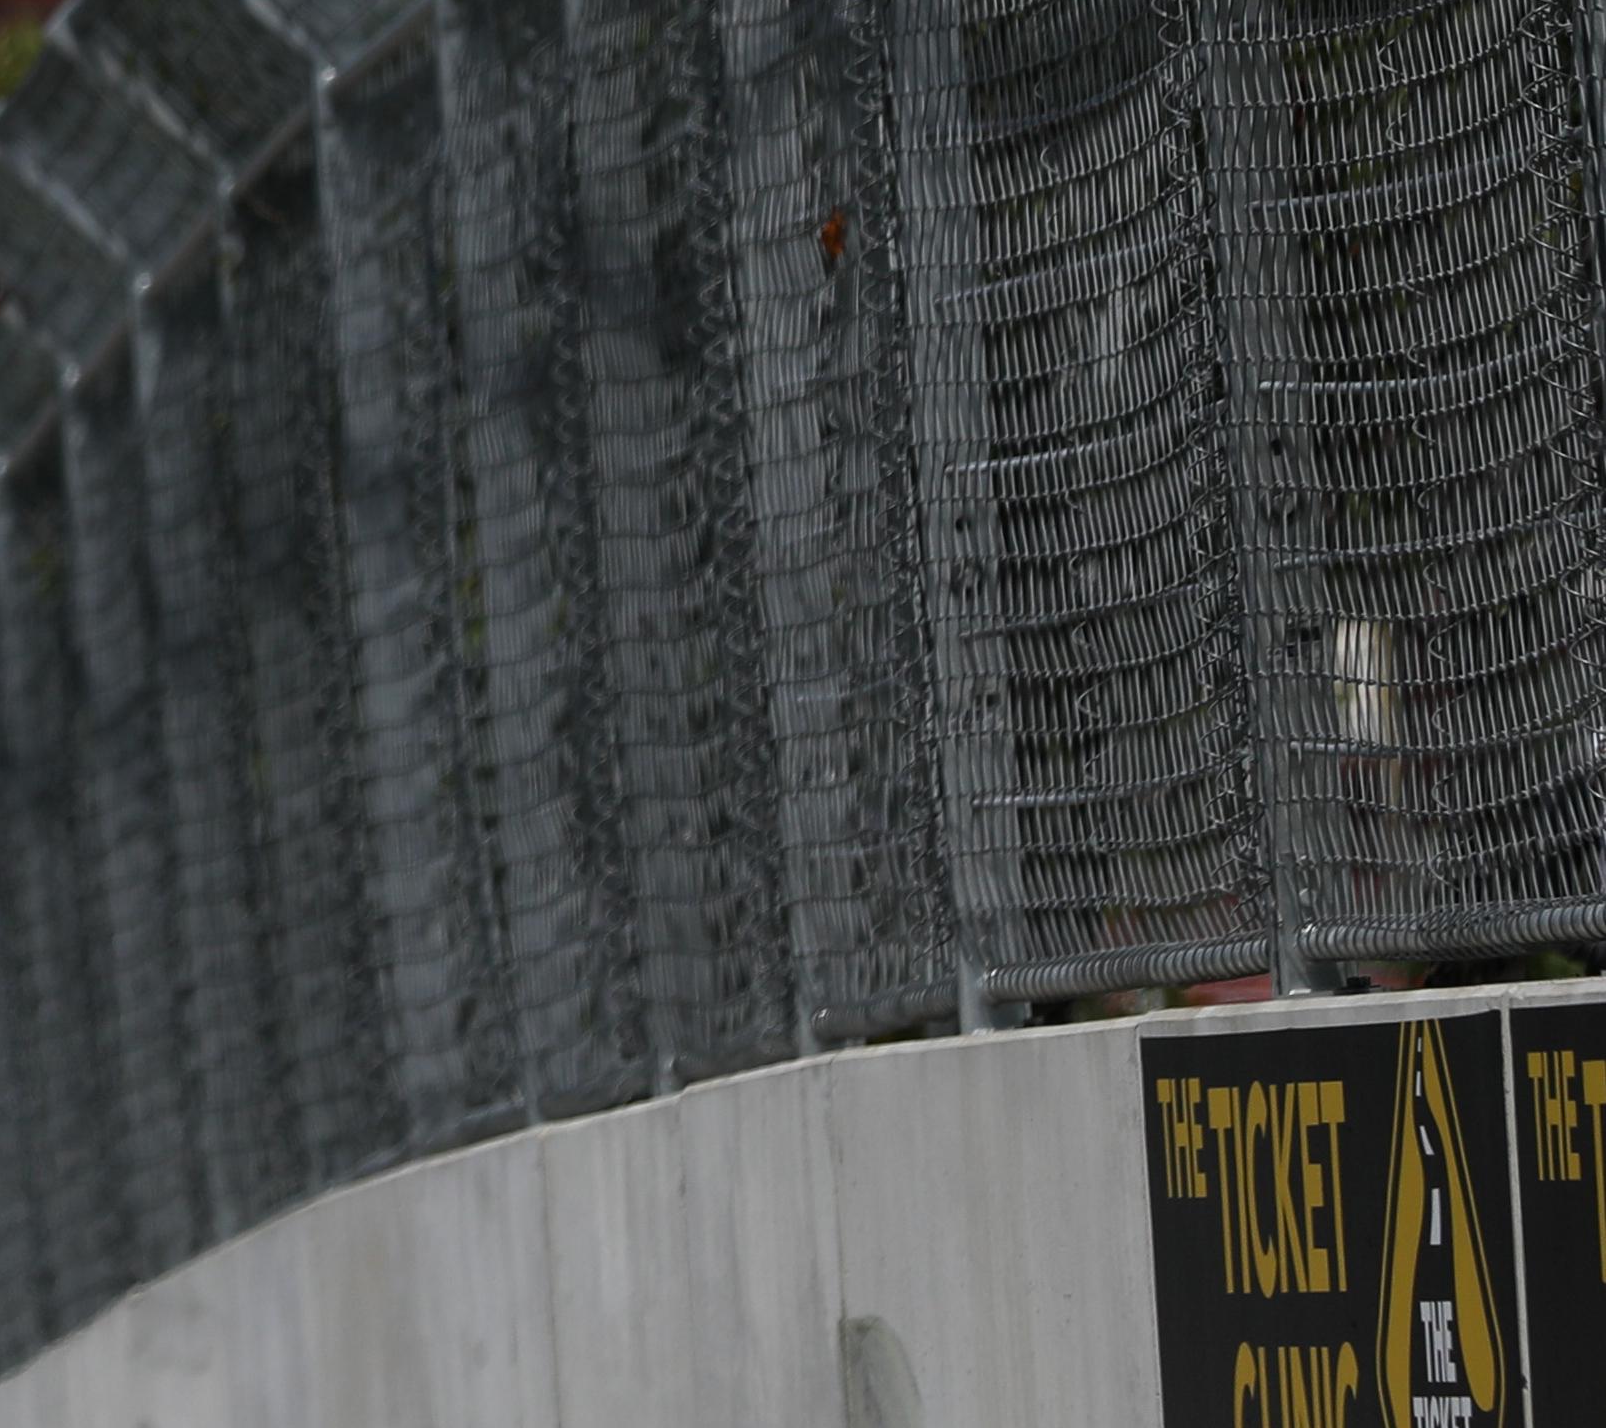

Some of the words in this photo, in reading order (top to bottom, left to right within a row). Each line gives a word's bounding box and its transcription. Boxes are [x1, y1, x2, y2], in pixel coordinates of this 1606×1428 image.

[1527, 1050, 1582, 1181] THE
[1156, 1077, 1208, 1198] THE
[1207, 1080, 1347, 1299] TICKET
[1419, 1300, 1457, 1383] THE
